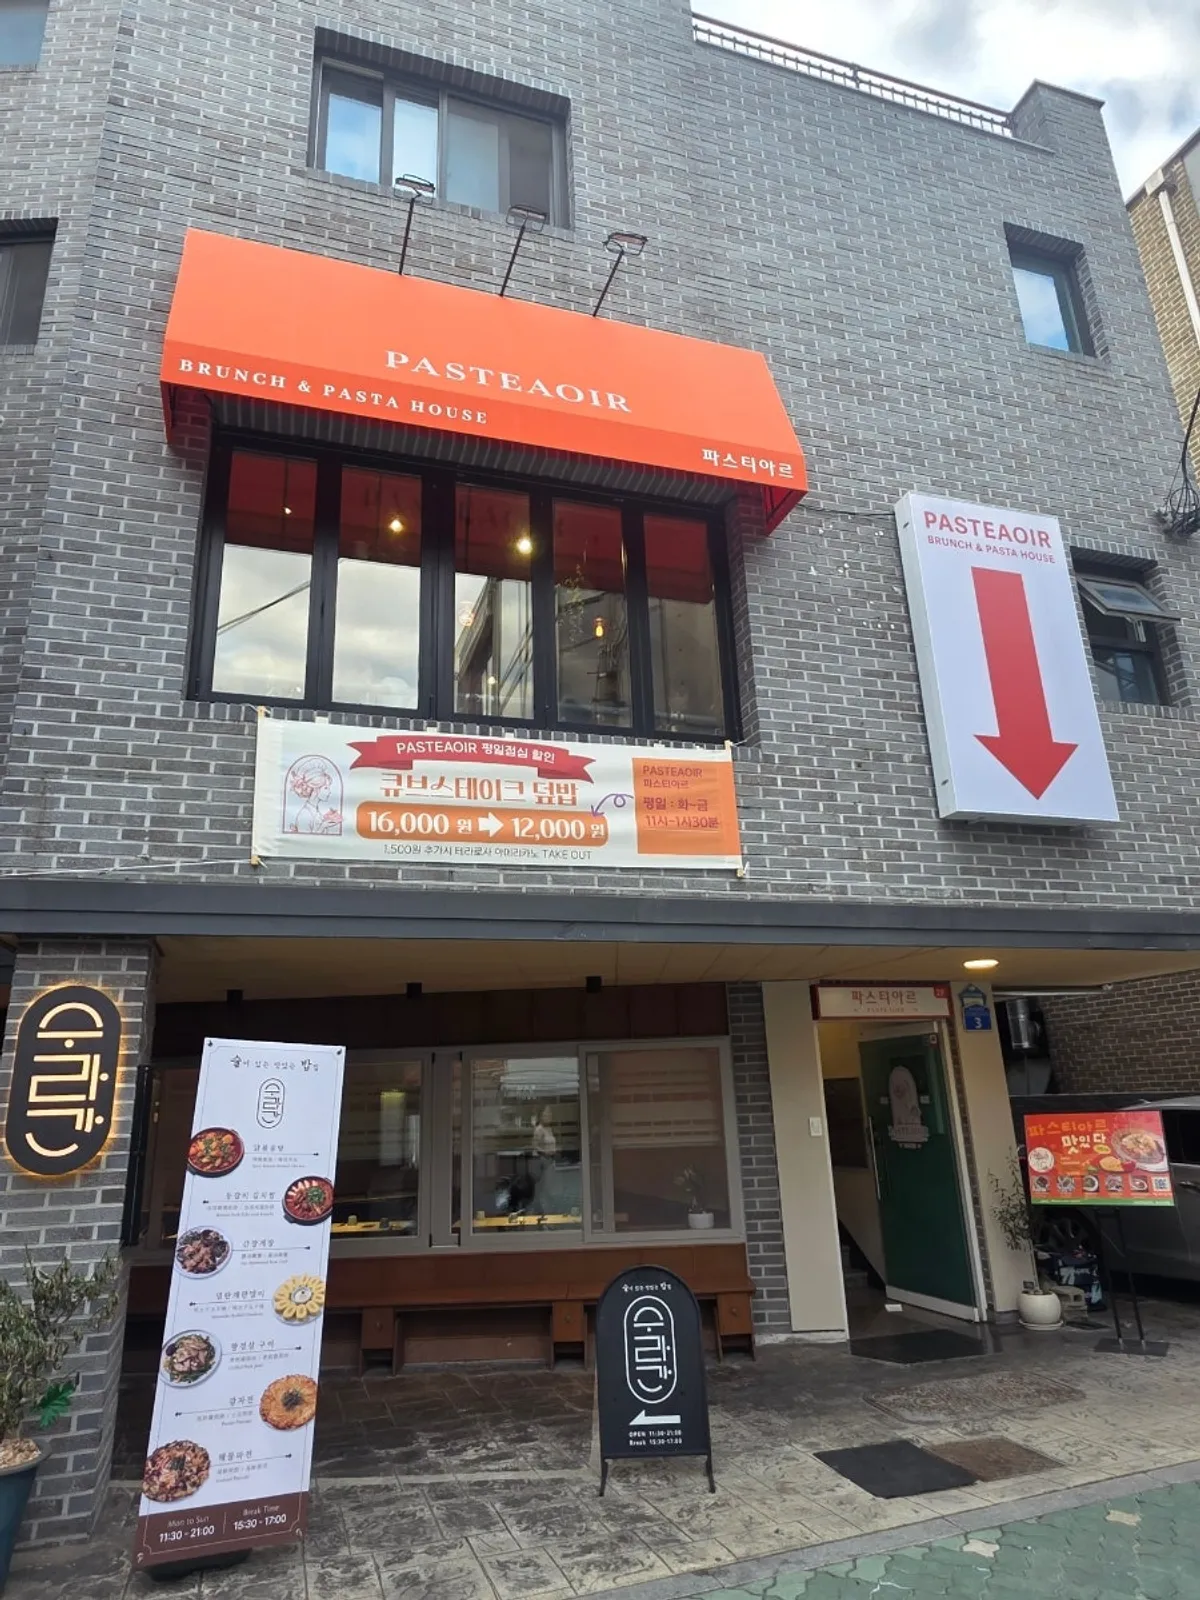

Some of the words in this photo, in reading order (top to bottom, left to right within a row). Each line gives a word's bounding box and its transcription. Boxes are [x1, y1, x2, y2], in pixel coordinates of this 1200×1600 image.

[385, 349, 631, 413] PASTEAOIR
[178, 358, 286, 389] BRUNCH
[297, 379, 311, 394] &
[323, 384, 398, 409] PASTA
[410, 400, 488, 424] HOUSE
[702, 447, 794, 480] 파스티아르
[924, 510, 1052, 549] PASTEAOIR
[927, 535, 973, 551] BRUNCH
[975, 543, 984, 553] &
[985, 544, 1018, 558] PASTA
[1020, 549, 1056, 564] HOUSE
[396, 741, 478, 754] PASTEAOIR
[482, 744, 528, 759] 평일점심
[532, 749, 556, 764] 할인
[642, 765, 703, 778] PASTEAOIR
[380, 772, 526, 802] 큐브스테이크
[533, 780, 579, 806] 덮밥
[643, 779, 690, 789] 파스티아르
[643, 796, 667, 811] 평일
[677, 798, 708, 812] 화~금
[367, 811, 449, 836] 16,000
[456, 818, 473, 835] 원
[510, 817, 585, 840] 12,000
[590, 823, 606, 839] 원
[543, 849, 568, 860] TAKE
[570, 850, 592, 860] OUT
[851, 989, 917, 1005] 파스티아르
[973, 1016, 983, 1029] 3
[1028, 1118, 1110, 1137] 파스티아르
[234, 1517, 258, 1531] 15:30
[264, 1513, 288, 1527] 17:00
[159, 1530, 182, 1543] 11:30
[190, 1525, 215, 1539] 21:00
